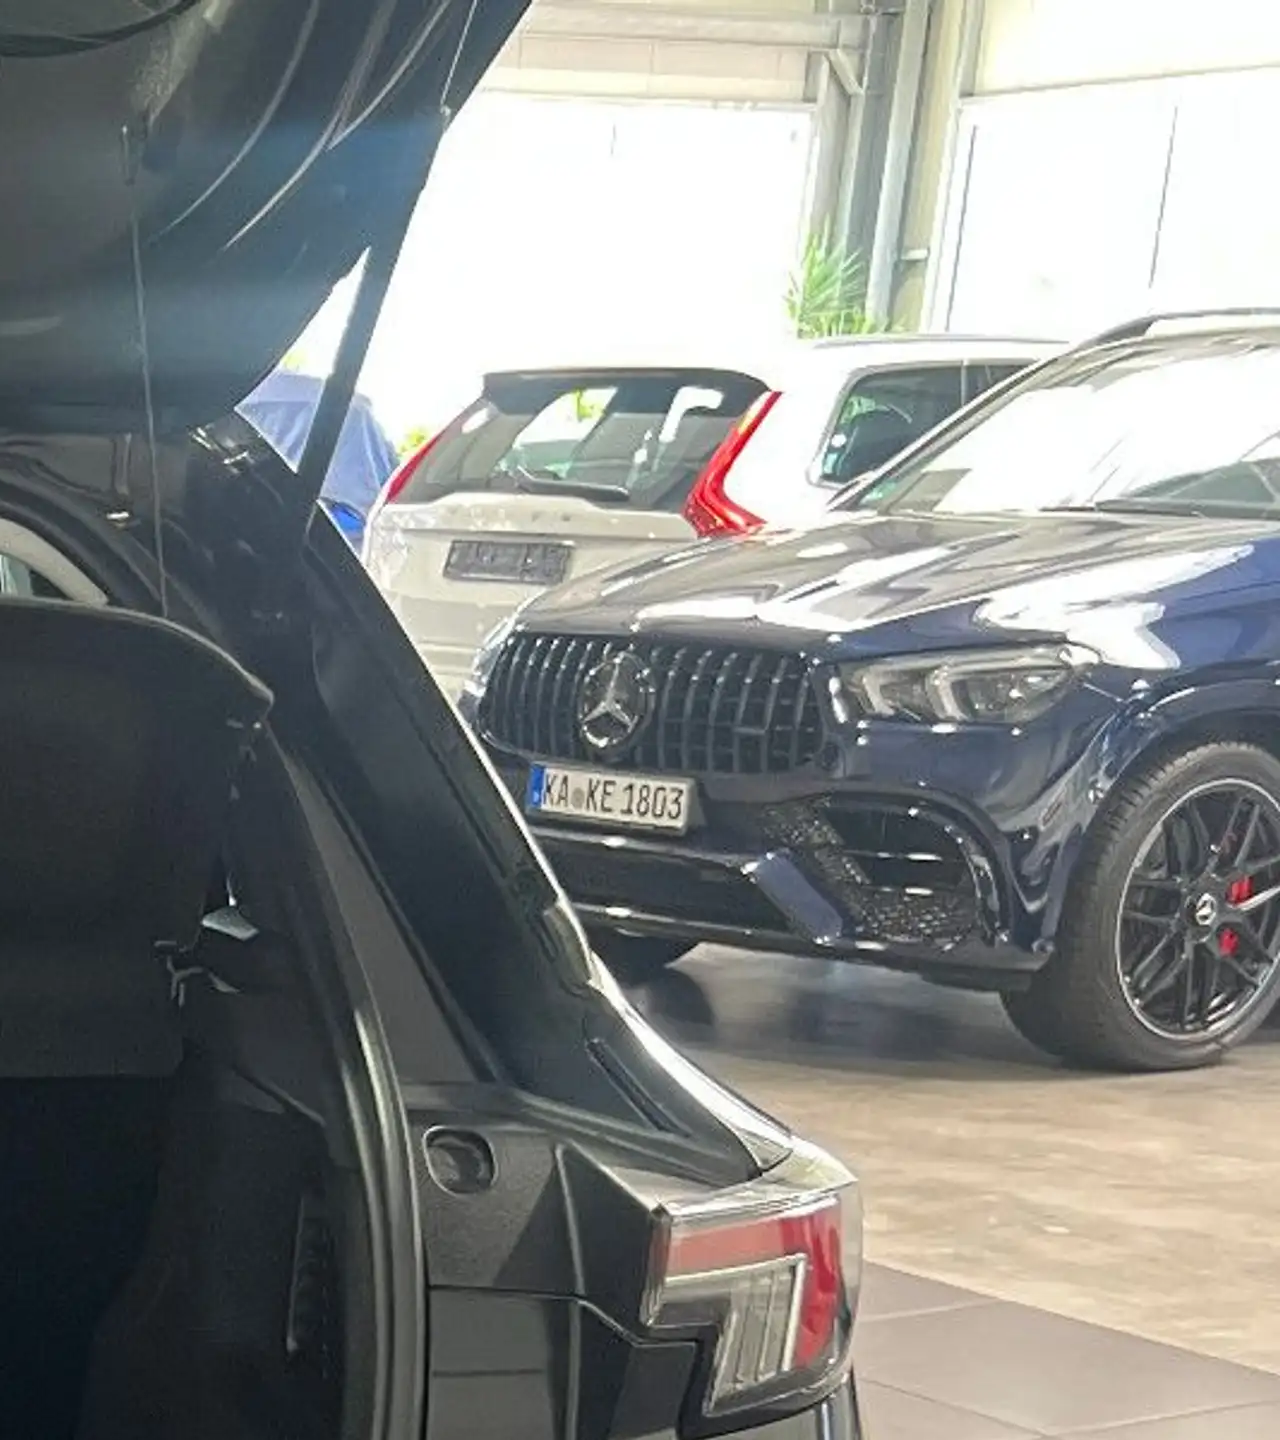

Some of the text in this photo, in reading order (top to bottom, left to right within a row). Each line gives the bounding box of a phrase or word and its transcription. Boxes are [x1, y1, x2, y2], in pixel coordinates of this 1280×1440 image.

[543, 773, 685, 820] KA KE 1803
